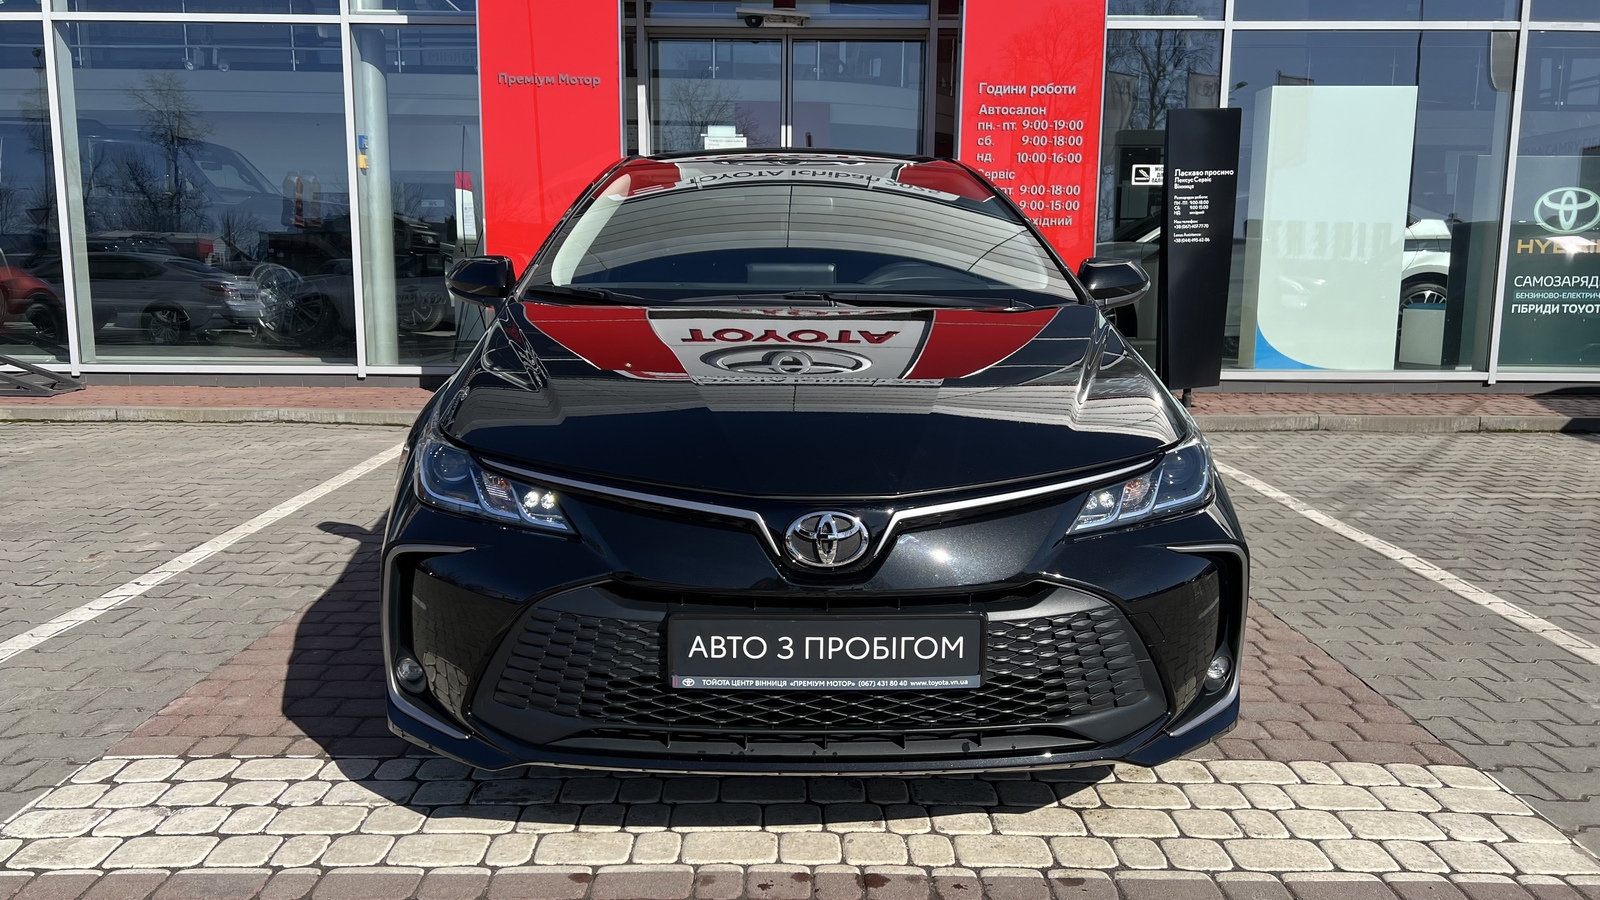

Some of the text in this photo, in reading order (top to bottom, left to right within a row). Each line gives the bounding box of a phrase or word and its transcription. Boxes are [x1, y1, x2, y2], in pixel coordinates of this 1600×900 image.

[498, 73, 601, 88] Преміум Мотор
[978, 83, 1076, 97] Години роботи
[978, 104, 1046, 115] Автосалон
[1022, 120, 1084, 131] 9:00-19:00
[977, 135, 1083, 146] сб. 9:00-18:00
[976, 152, 1082, 164] нд. 10:00-16:00
[1019, 185, 1080, 196] 9:00-18:00
[1019, 200, 1080, 211] 9:00-15:00
[1511, 304, 1559, 315] ГІБРИДИ
[688, 635, 964, 660] АВТО З ПРОБІГОМ
[702, 679, 730, 687] ТОЙОТА
[731, 679, 754, 687] ЦЕНТР
[755, 679, 787, 687] ВІННИЦЯ
[789, 679, 825, 688] «ПРЕМІУМ
[910, 679, 969, 687] www.toyota.vn.ua
